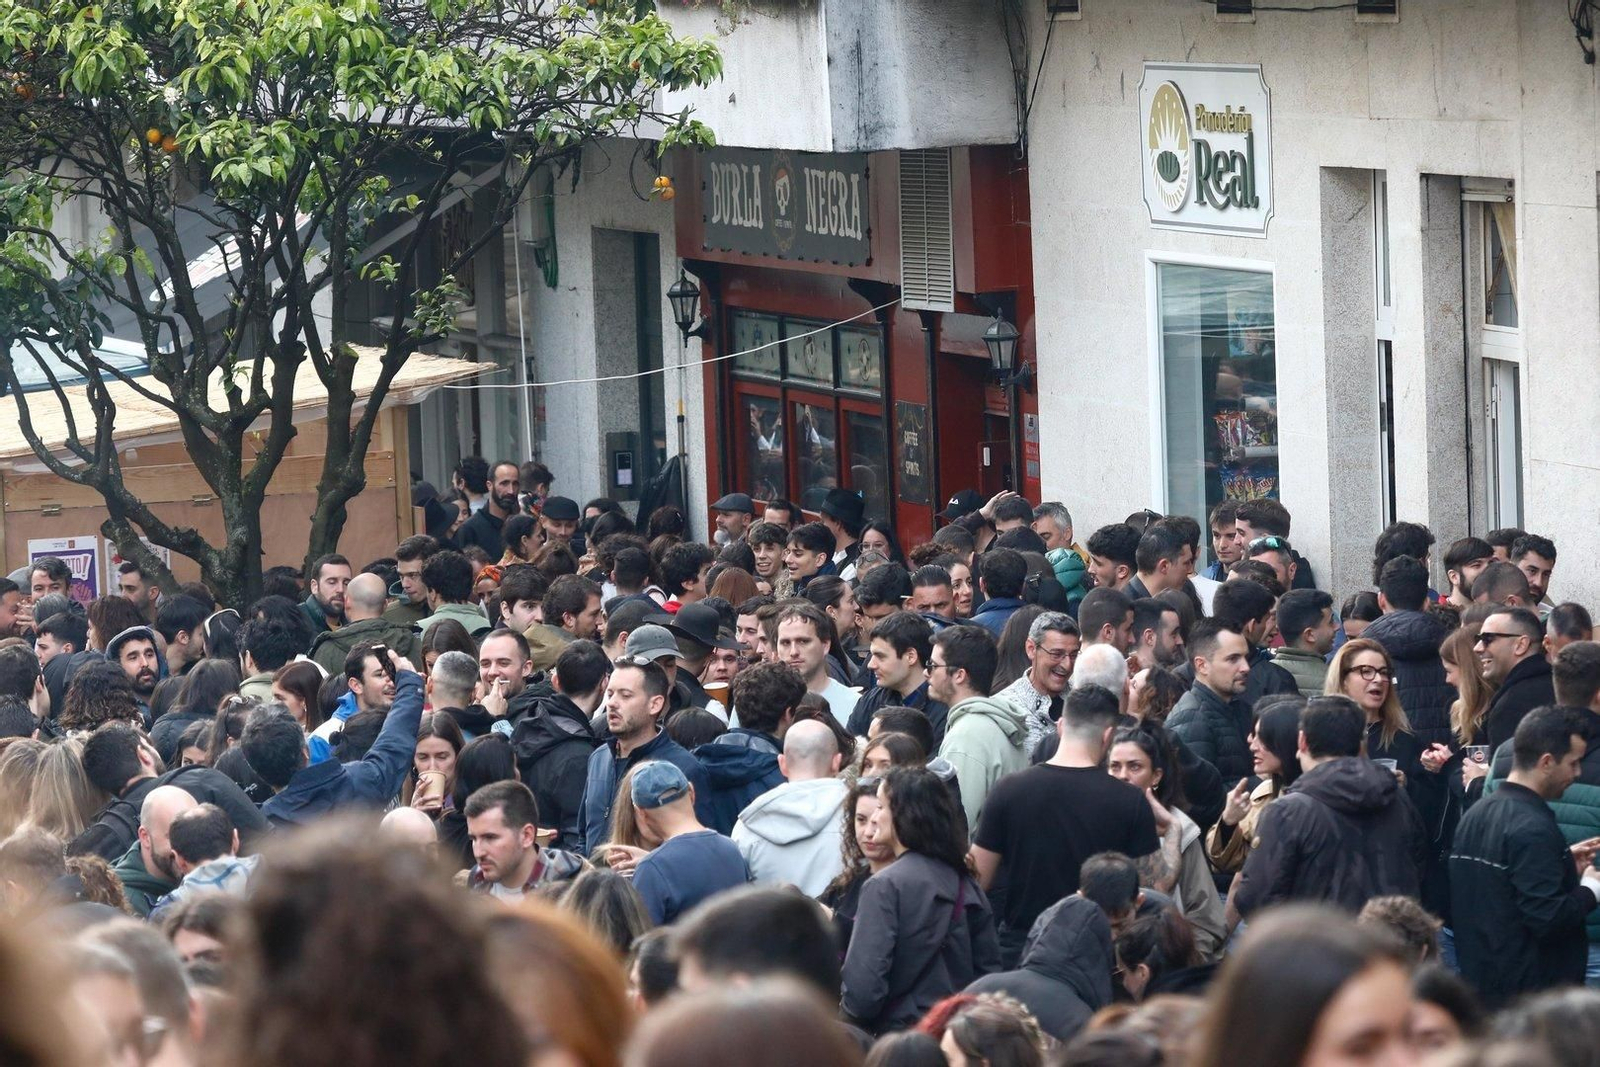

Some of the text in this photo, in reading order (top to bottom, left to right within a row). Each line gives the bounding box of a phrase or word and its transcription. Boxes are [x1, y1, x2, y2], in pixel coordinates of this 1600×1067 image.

[711, 162, 862, 241] BURLA NEGRA
[1192, 132, 1259, 210] Real
